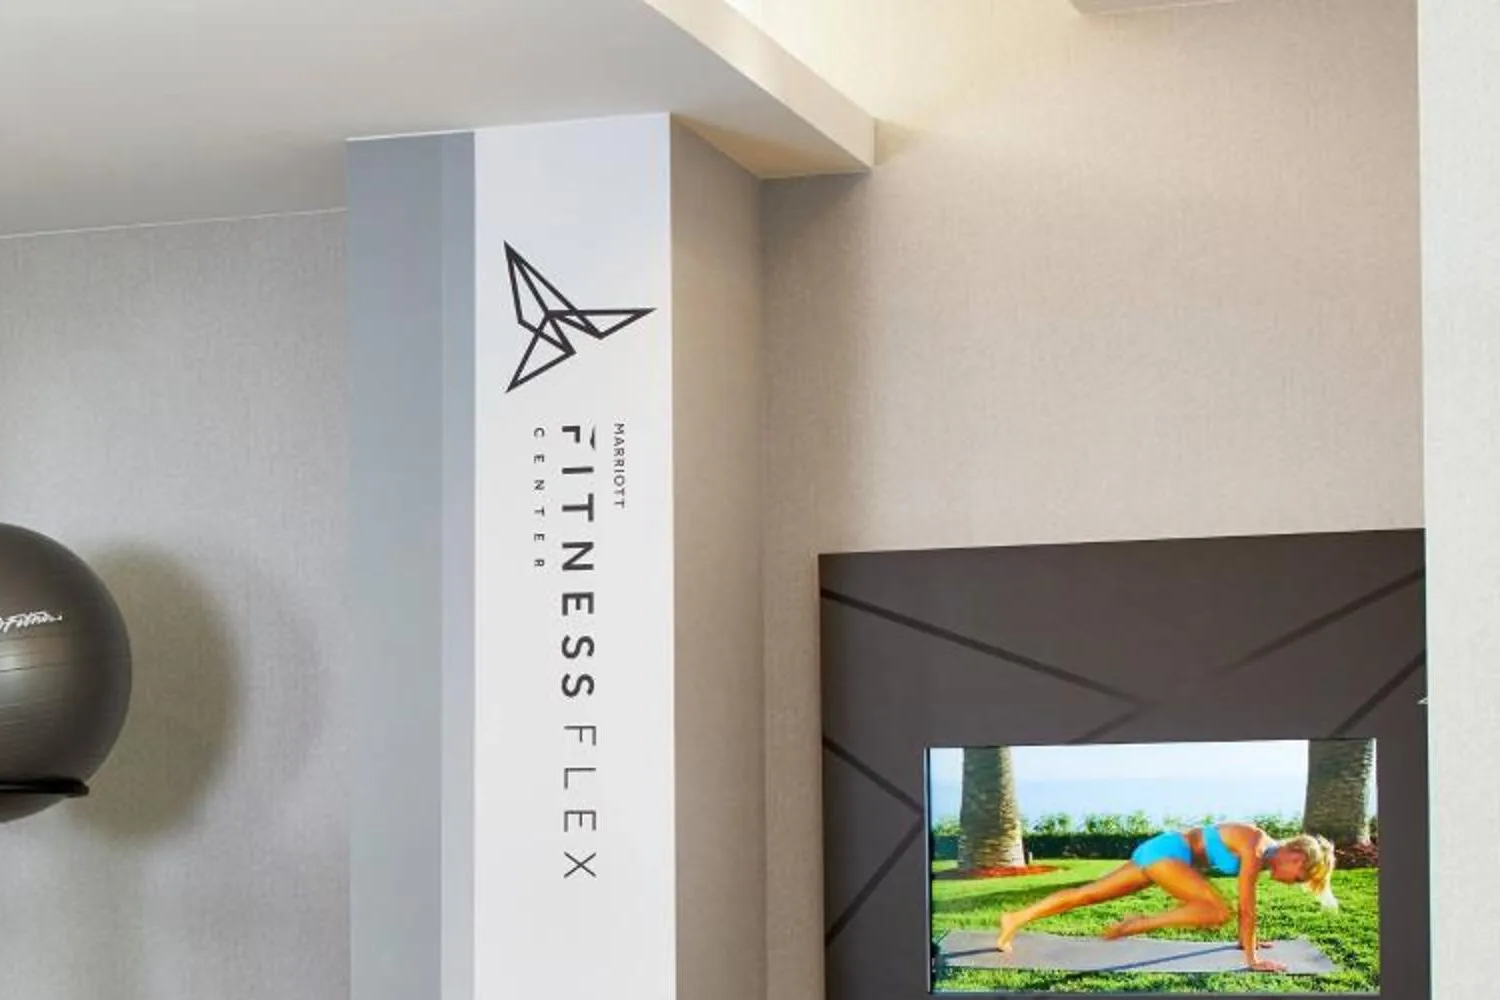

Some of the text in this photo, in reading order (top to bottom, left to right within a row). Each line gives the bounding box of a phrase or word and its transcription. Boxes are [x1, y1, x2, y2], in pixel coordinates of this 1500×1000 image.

[533, 427, 545, 567] CENTER
[613, 423, 625, 508] MARRIOTT
[561, 425, 597, 878] FITNESS FLEX
